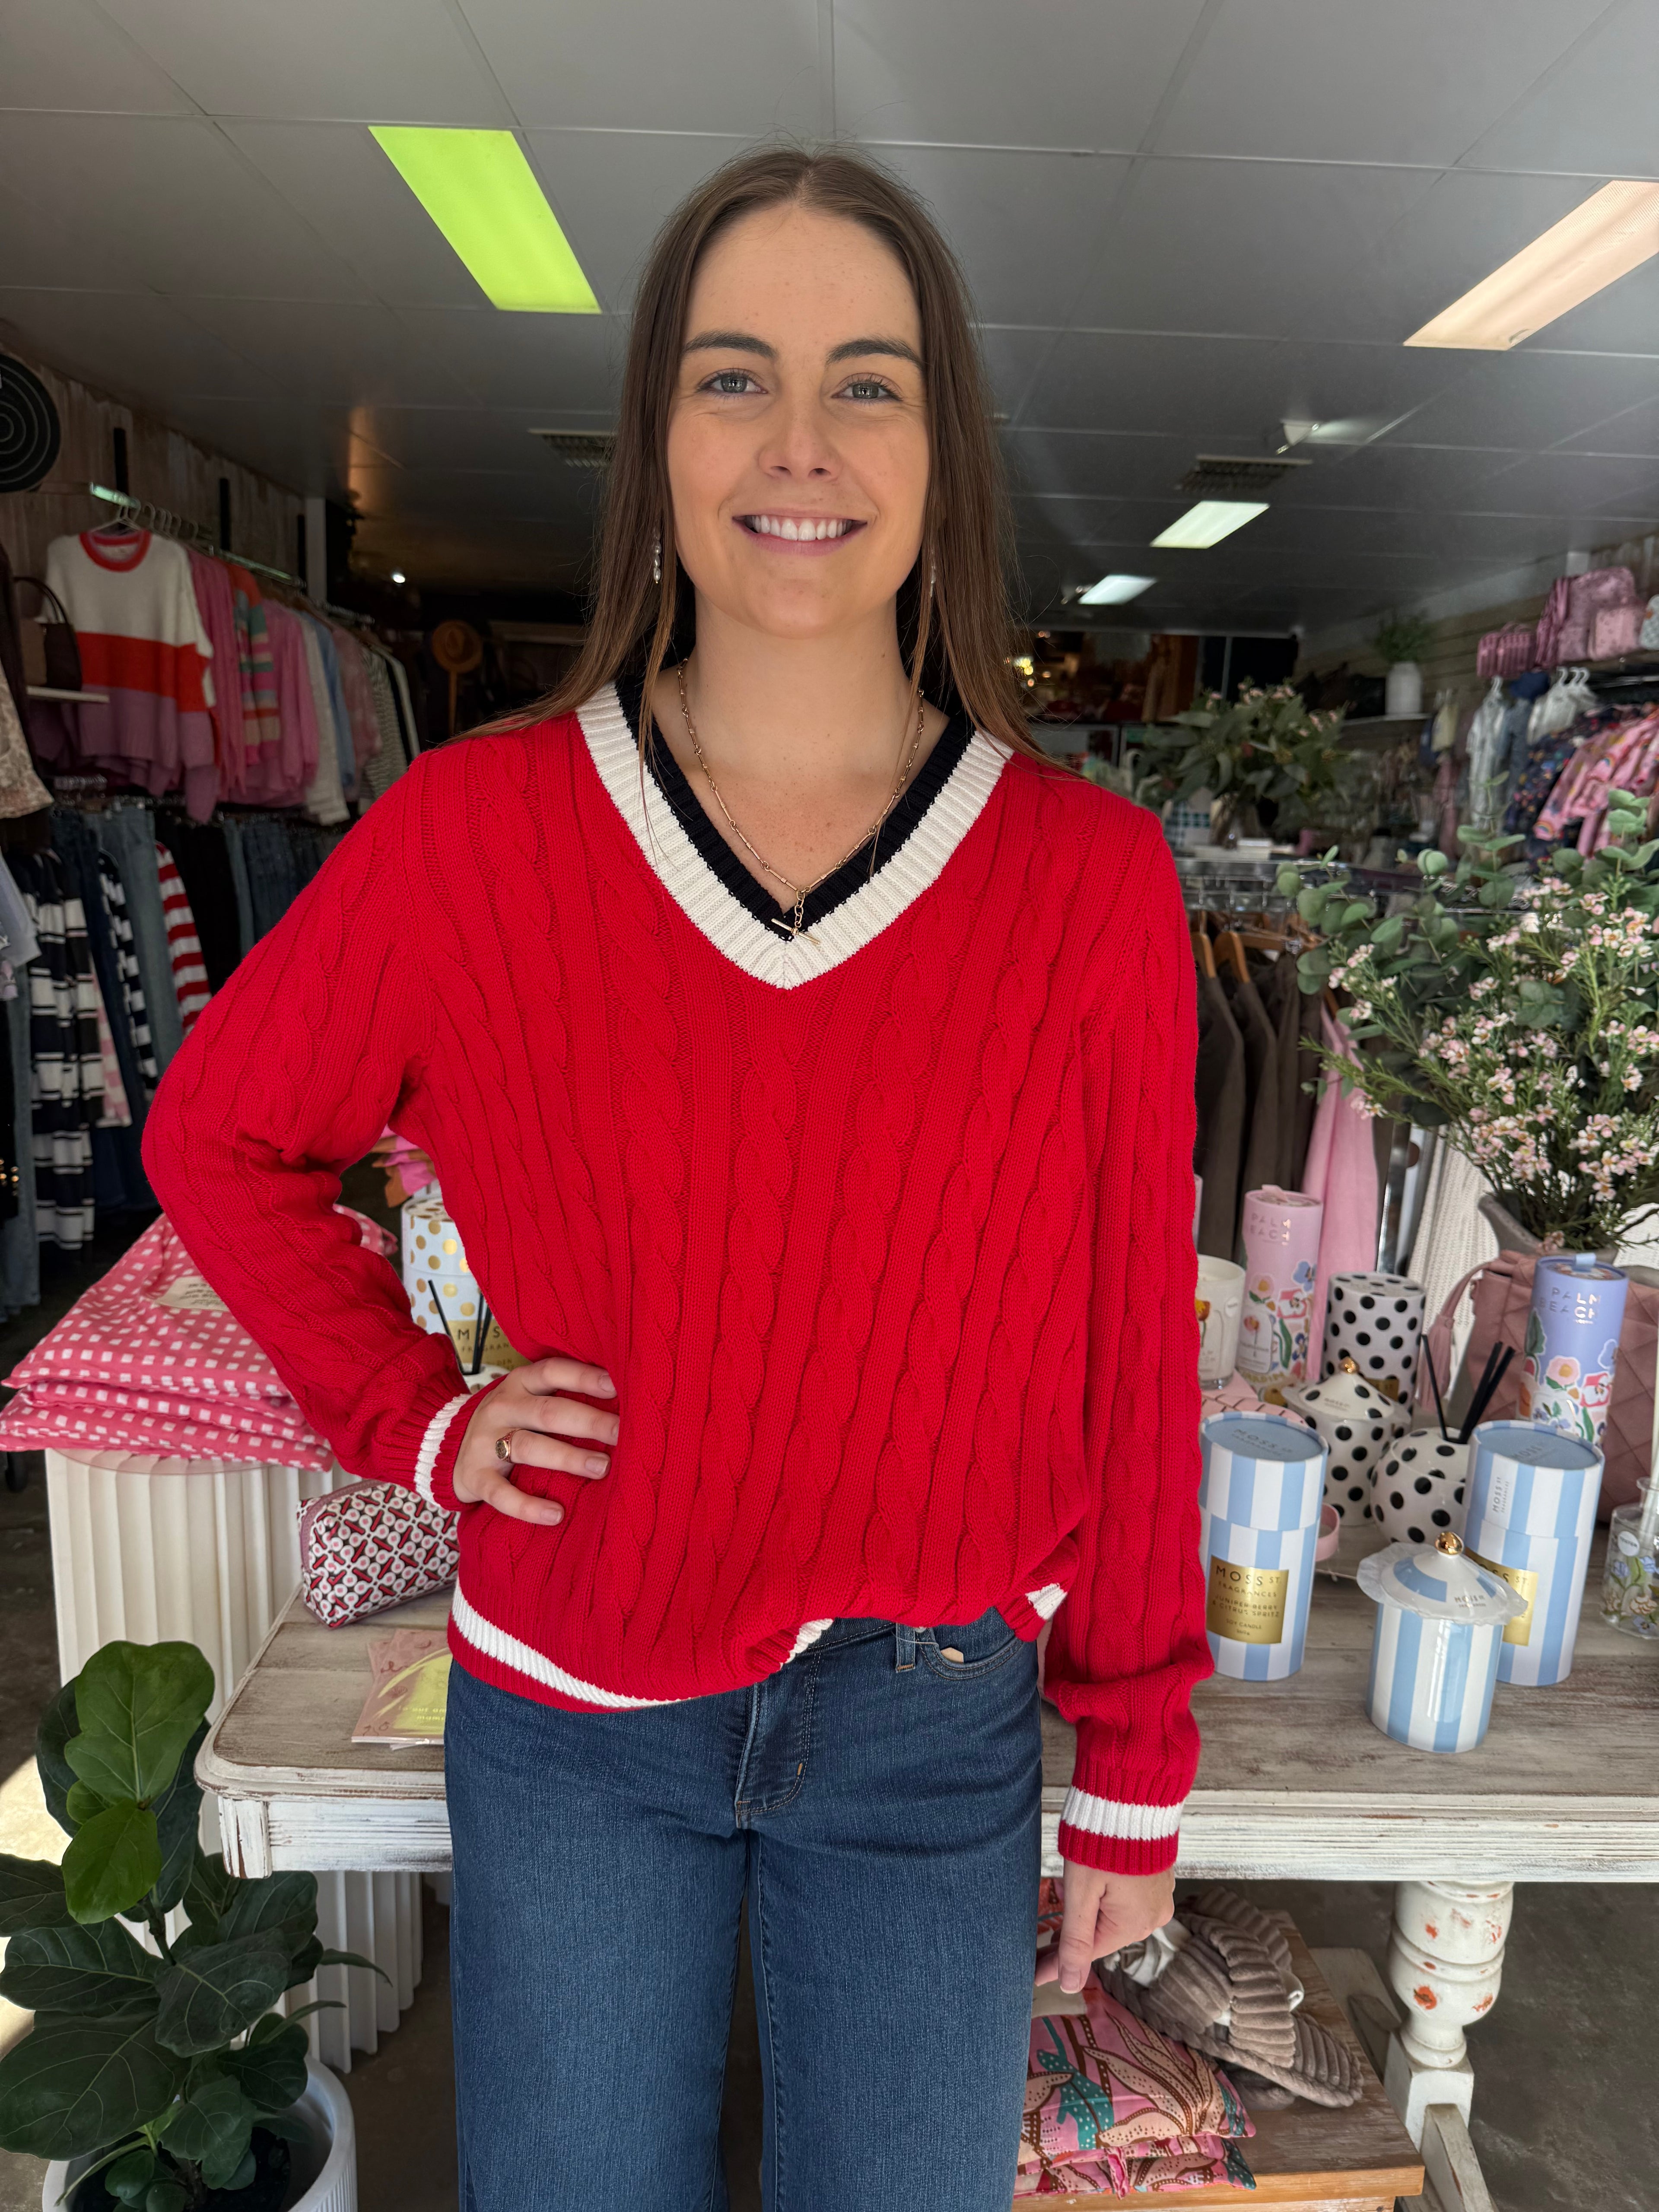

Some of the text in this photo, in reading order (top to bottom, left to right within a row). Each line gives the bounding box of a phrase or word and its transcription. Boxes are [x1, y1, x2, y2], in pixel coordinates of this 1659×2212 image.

[1251, 1212, 1291, 1229] PALM
[1552, 1287, 1601, 1305] PALM
[1539, 1297, 1597, 1319] BEACH
[1492, 1485, 1503, 1513] MOSS
[1216, 1565, 1263, 1586] MOSS
[1218, 1581, 1277, 1597] FRAGRANCES
[1216, 1595, 1249, 1608] JUNIPER
[1220, 1603, 1248, 1615] CITRUS
